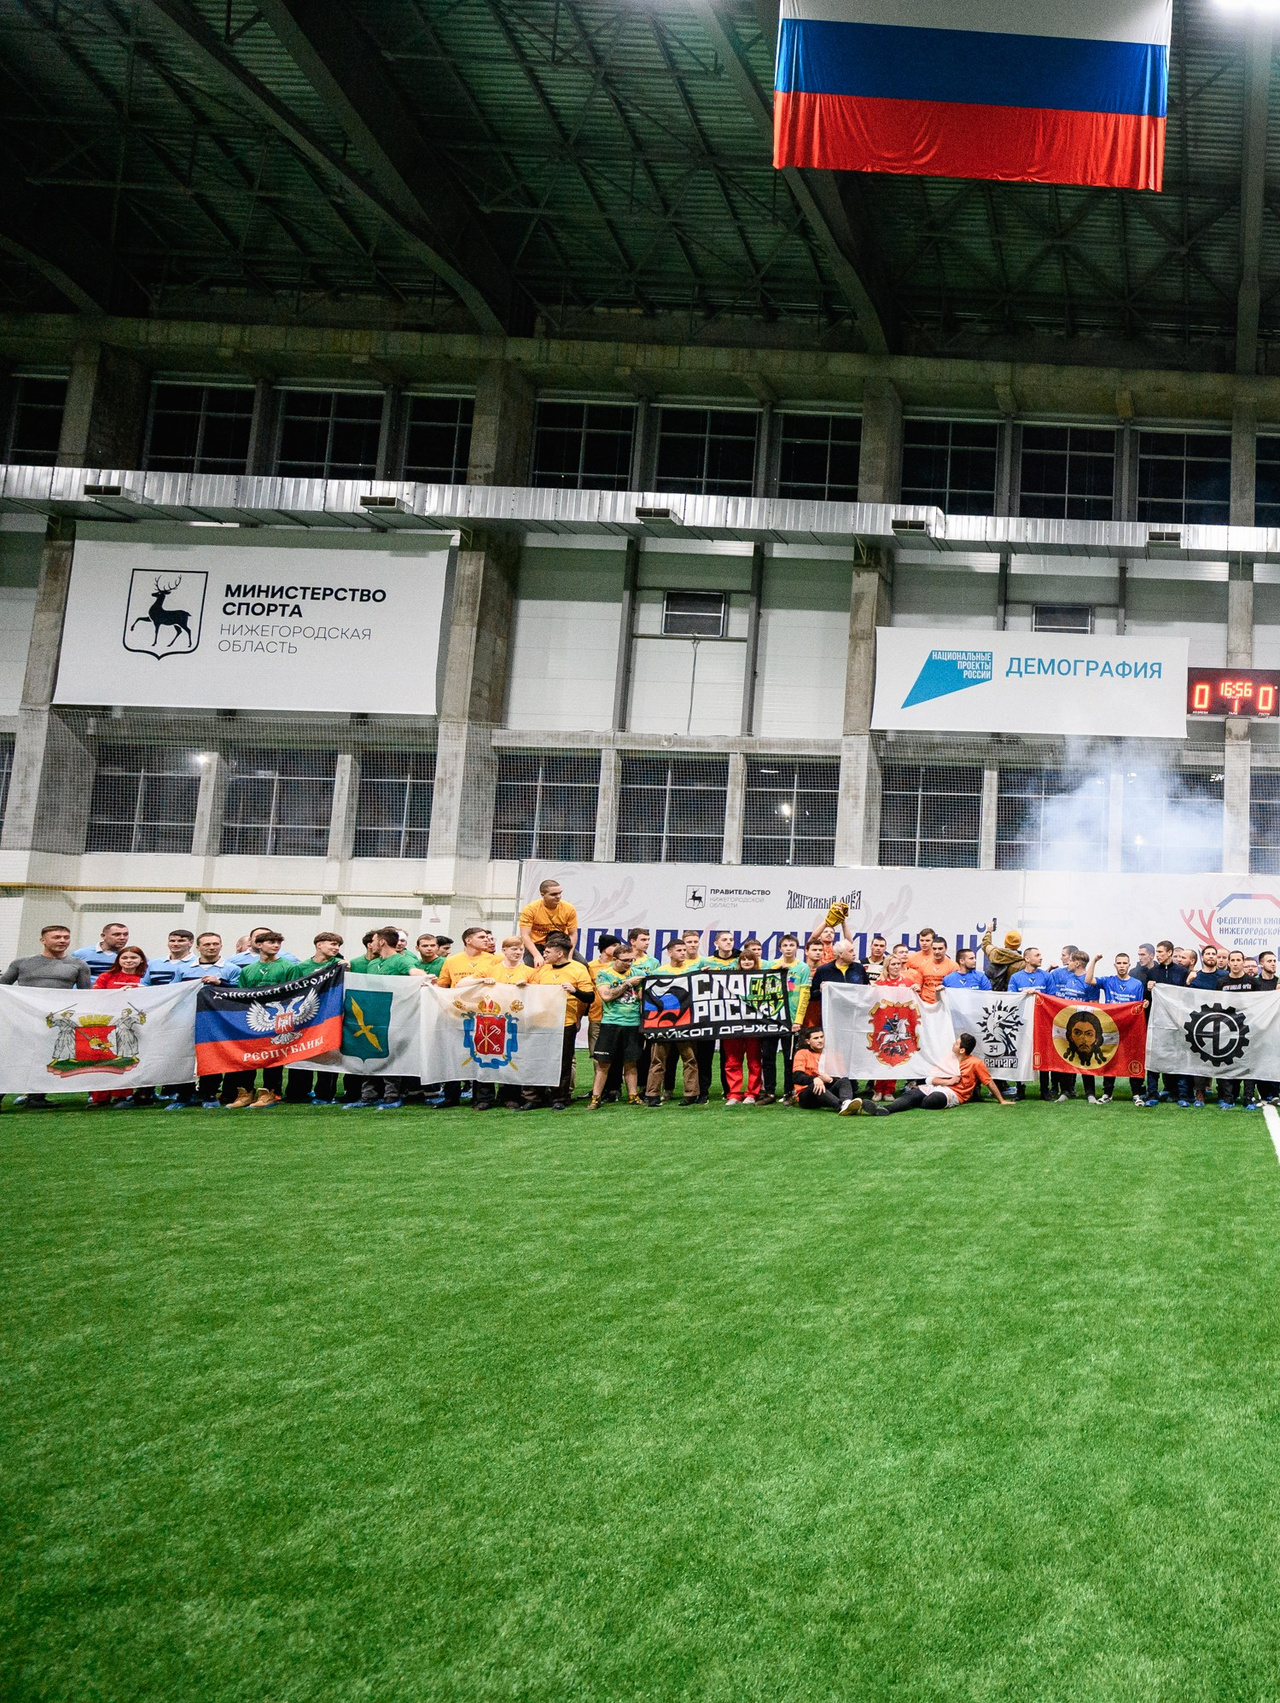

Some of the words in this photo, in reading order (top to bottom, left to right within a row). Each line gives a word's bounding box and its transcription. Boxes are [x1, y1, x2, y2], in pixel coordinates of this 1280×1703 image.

[224, 584, 387, 603] МИНИСТЕРСТВО
[222, 602, 303, 618] СПОРТА
[219, 623, 372, 641] НИЖЕГОРОДСКАЯ
[218, 639, 298, 655] ОБЛАСТЬ
[932, 651, 992, 661] НАЦИОНАЛЬНЫЕ
[957, 661, 992, 670] ПРОЕКТЫ
[1005, 656, 1163, 679] ДЕМОГРАФИЯ
[963, 670, 991, 679] РОССИИ
[1220, 682, 1253, 697] 16:56
[1194, 684, 1210, 709] 0
[1258, 686, 1273, 711] 0
[1234, 699, 1239, 712] 1
[710, 888, 771, 896] ПРАВИТЕЛЬСТВО
[1216, 916, 1262, 926] ФЕДЕРАЦИЯ
[1233, 938, 1268, 946] ОБЛАСТИ
[718, 1024, 790, 1035] ДРУЖБА
[989, 1045, 998, 1053] 34
